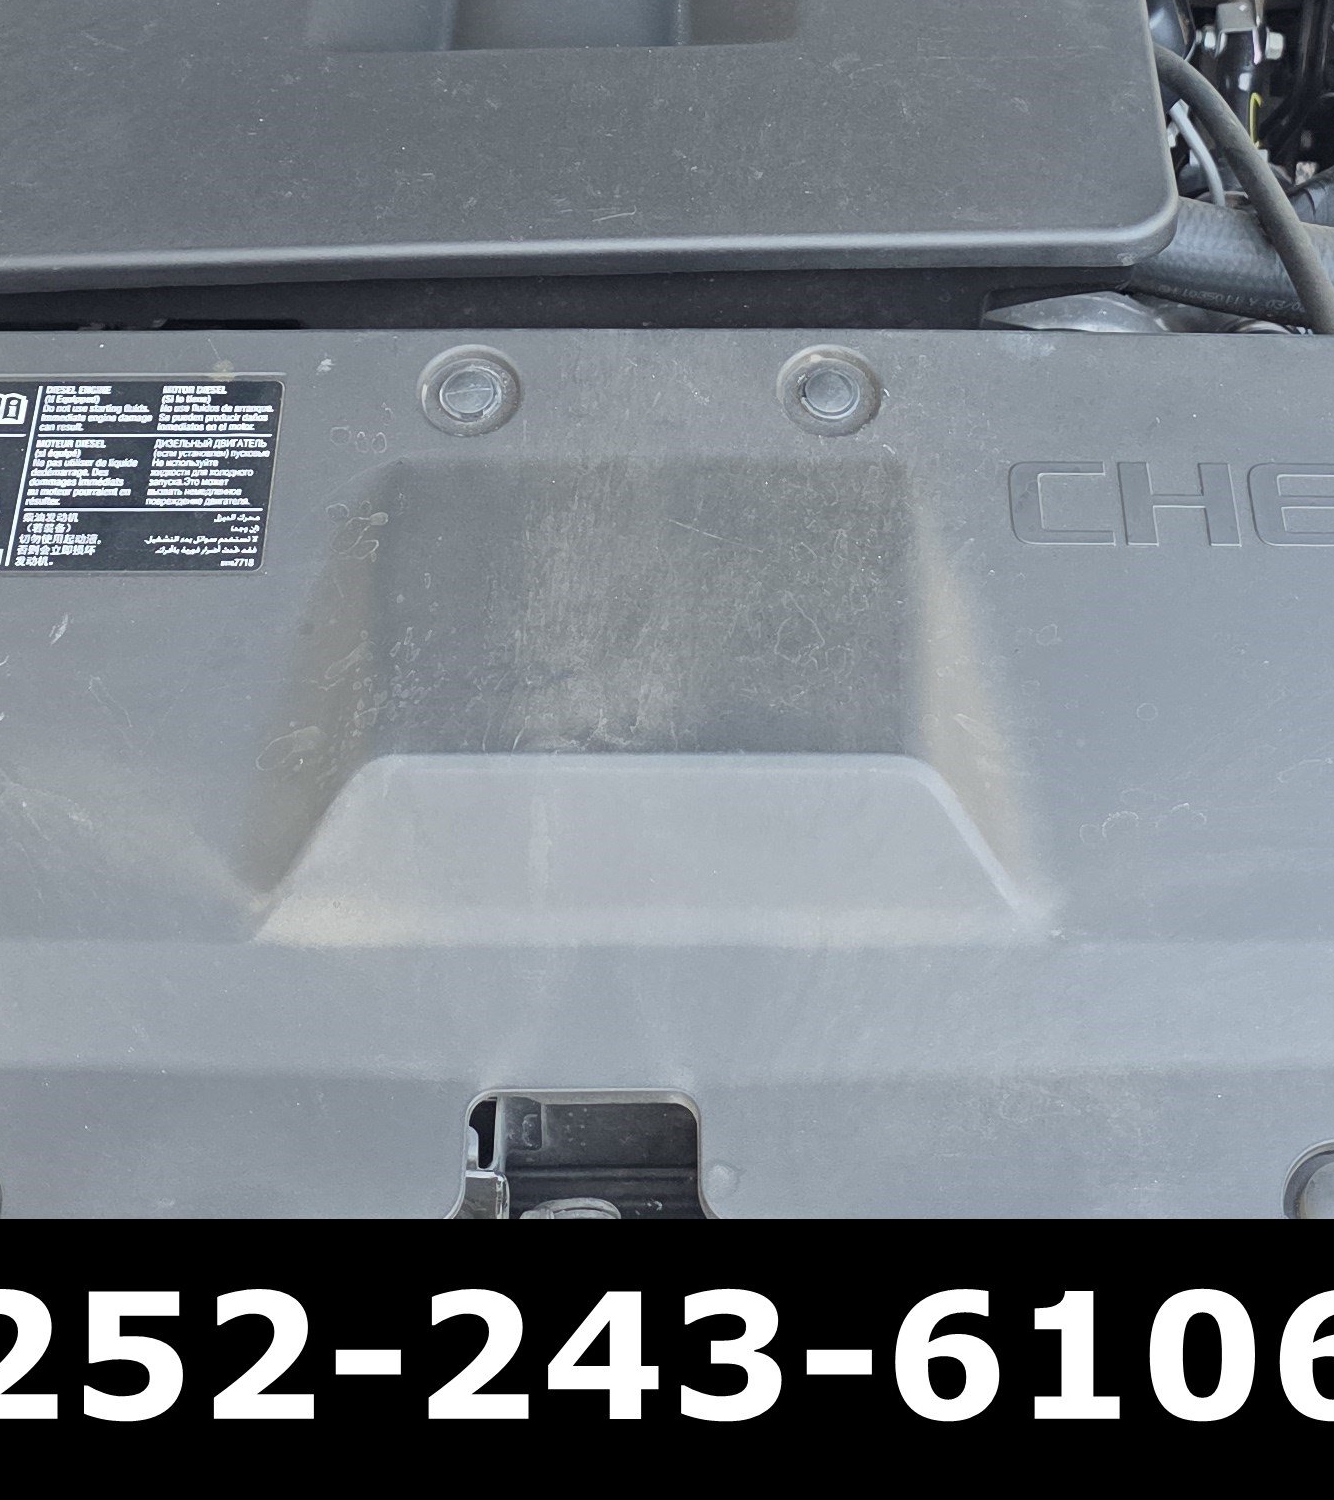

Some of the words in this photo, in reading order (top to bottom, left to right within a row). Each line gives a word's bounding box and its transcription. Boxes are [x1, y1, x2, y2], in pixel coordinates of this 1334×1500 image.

[46, 386, 77, 394] DIESEL
[78, 386, 112, 394] ENGINE
[163, 386, 195, 394] MOTOR
[196, 386, 227, 394] DIESEL
[56, 395, 100, 404] Equipped)
[89, 404, 122, 414] starting
[124, 404, 149, 412] fluids.
[160, 404, 172, 412] No
[192, 404, 220, 412] fluidos
[221, 404, 233, 412] de
[234, 405, 274, 413] arranque.
[87, 414, 117, 423] engine
[118, 414, 153, 423] damage
[159, 413, 171, 421] Se
[171, 413, 204, 423] pueden
[205, 413, 241, 423] producir
[242, 413, 268, 421] daños
[56, 423, 84, 431] result.
[218, 423, 227, 431] el
[228, 423, 255, 431] motor.
[75, 440, 106, 448] DIESEL
[154, 438, 213, 449] ДИЗЕЛЬНЫЙ
[213, 439, 267, 448] ДВИГАТЕЛЬ
[32, 459, 45, 467] Ne
[46, 460, 62, 468] pas
[64, 458, 95, 466] utiliser
[95, 458, 107, 467] de
[108, 458, 138, 468] liquide
[166, 459, 219, 468] используйте
[91, 468, 109, 476] Des
[29, 478, 77, 487] dommages
[40, 488, 72, 496] moteur
[72, 487, 118, 497] pourraient
[23, 513, 78, 522] 柴油发动机
